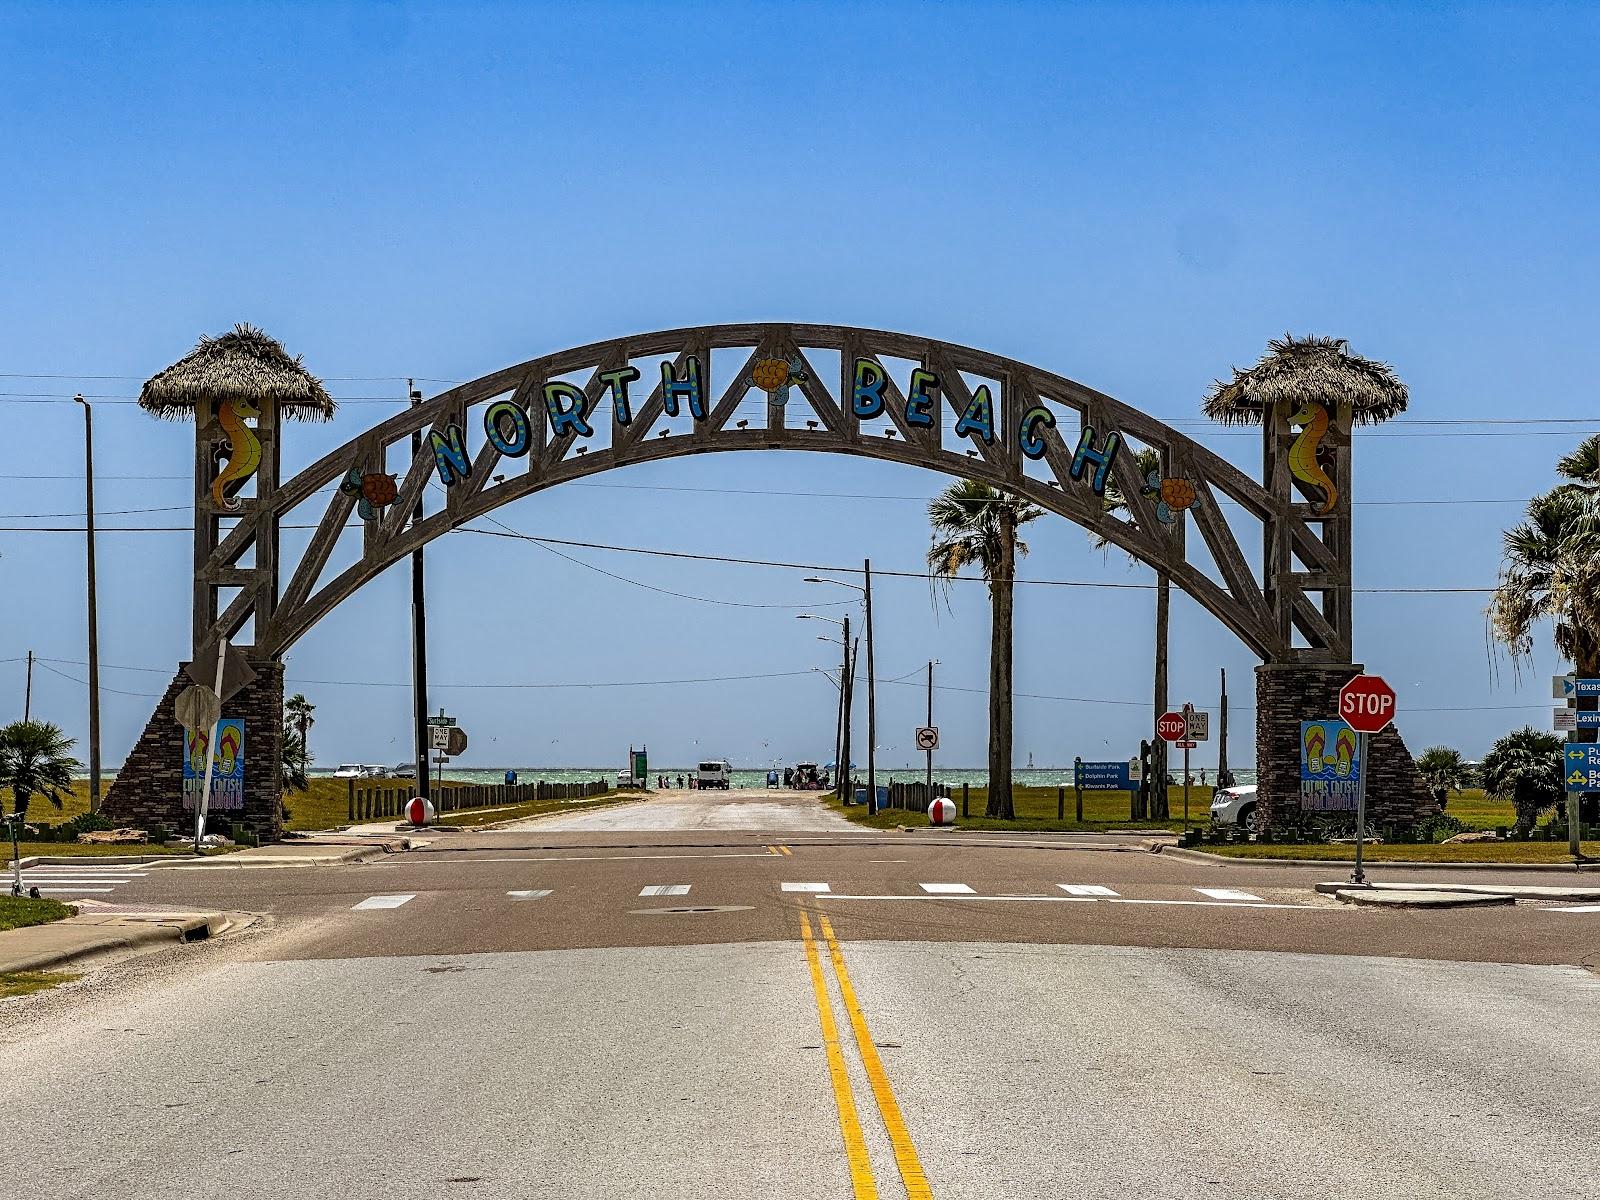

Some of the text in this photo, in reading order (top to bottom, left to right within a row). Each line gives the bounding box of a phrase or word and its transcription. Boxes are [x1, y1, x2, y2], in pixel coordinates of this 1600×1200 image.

[428, 355, 1122, 497] NORTH BEACH
[1576, 682, 1600, 691] Texas
[1343, 692, 1393, 715] STOP
[1189, 714, 1206, 722] ONE
[1576, 714, 1600, 723] Lexin
[1159, 721, 1184, 732] STOP
[1189, 722, 1206, 730] WAY
